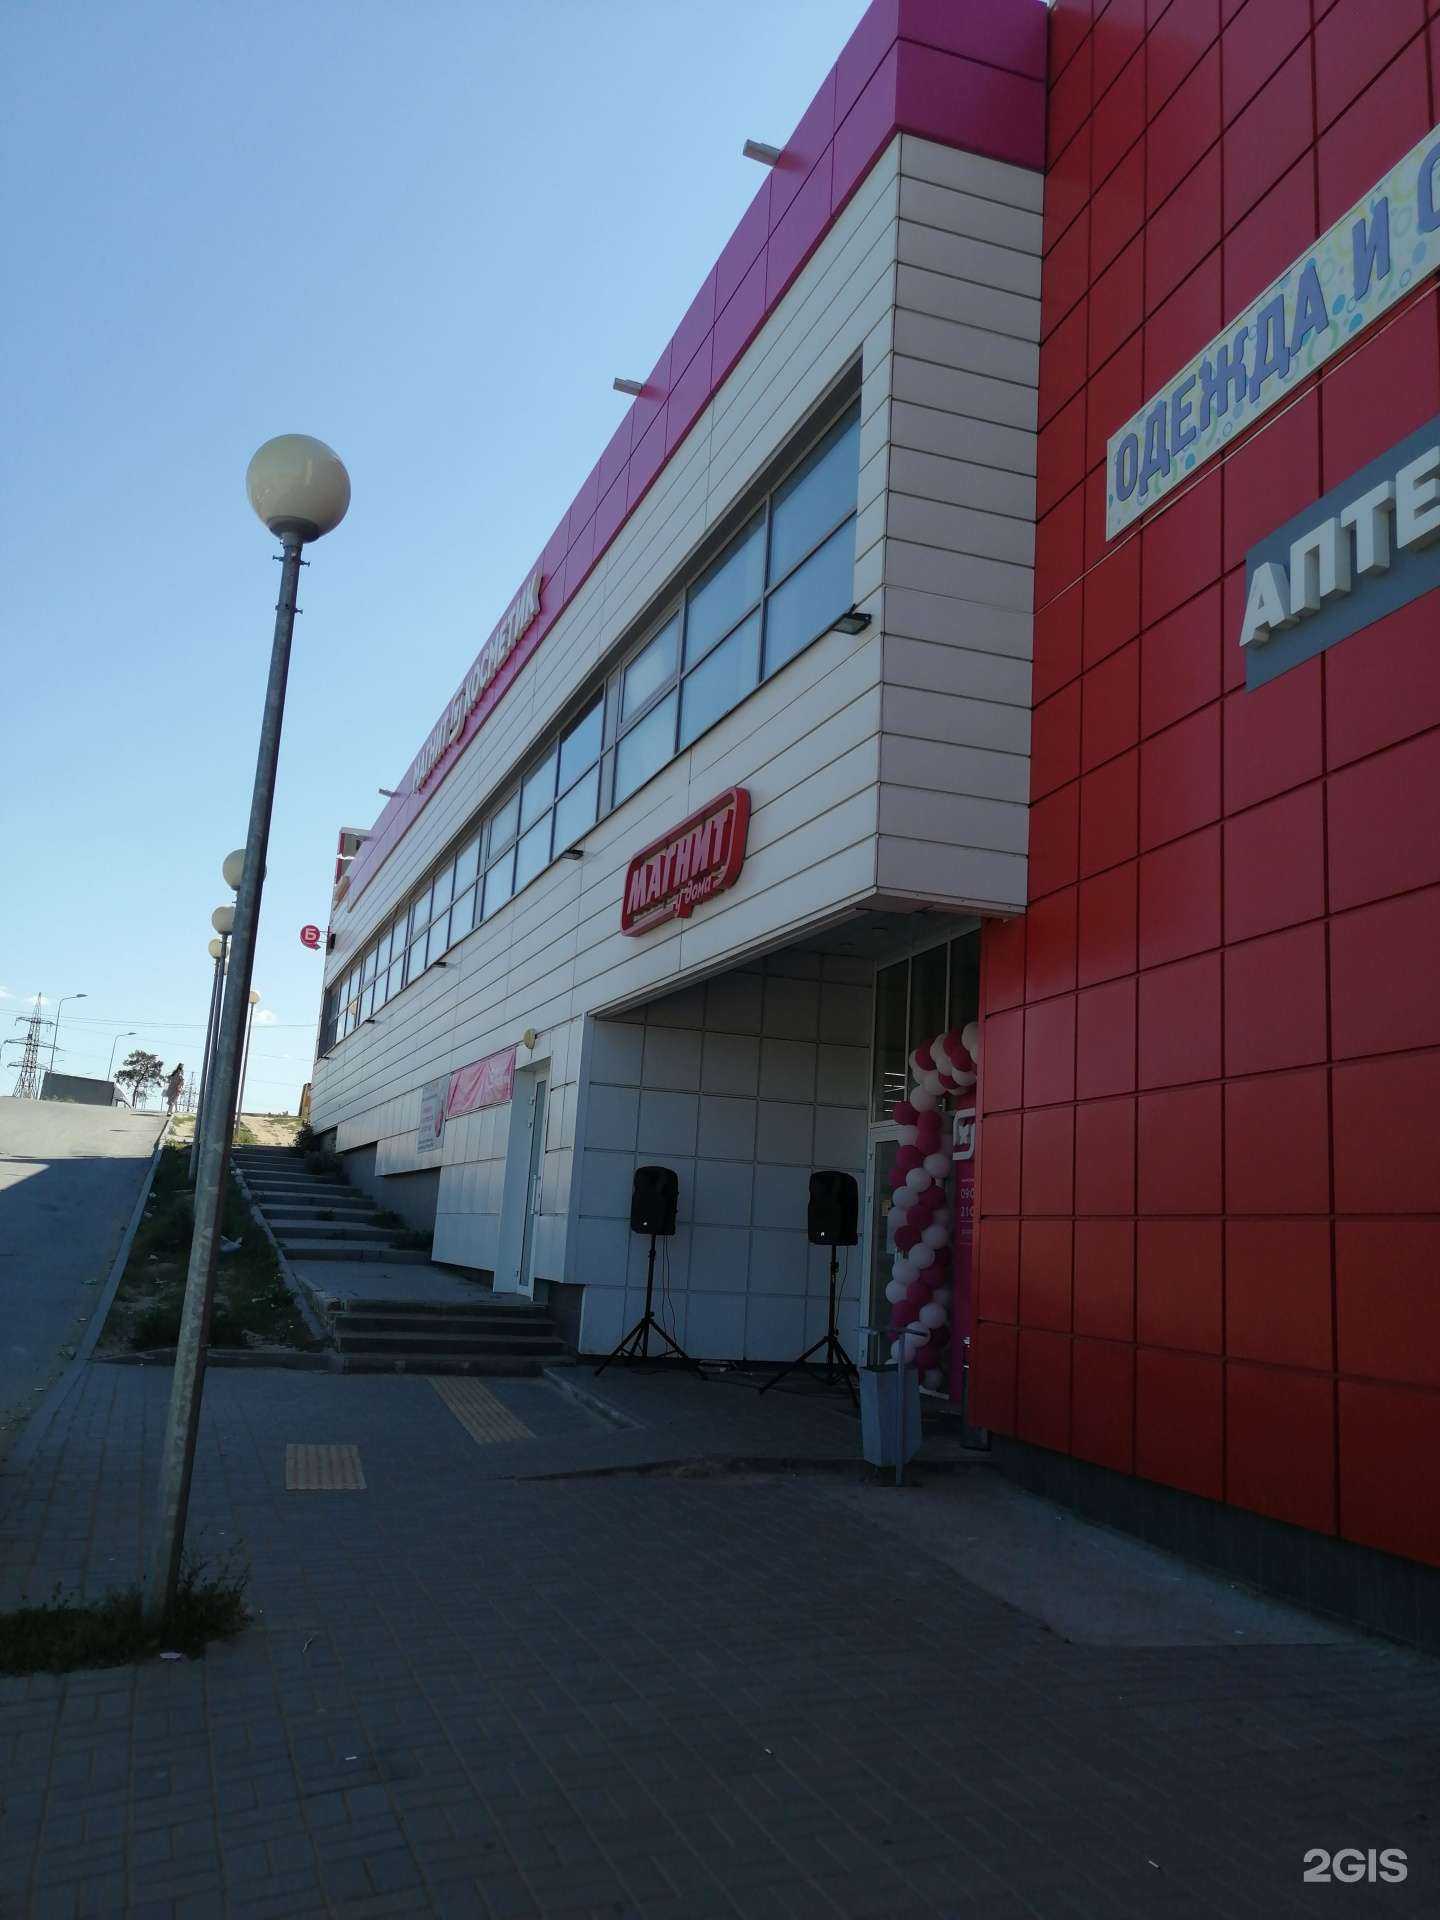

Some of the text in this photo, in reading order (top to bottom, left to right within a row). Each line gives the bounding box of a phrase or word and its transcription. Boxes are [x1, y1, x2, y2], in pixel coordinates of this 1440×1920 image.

[1114, 263, 1330, 502] ОДЕЖДА
[1351, 195, 1391, 302] И
[1239, 444, 1440, 648] АПТЕ
[627, 811, 729, 915] МАГНИТ
